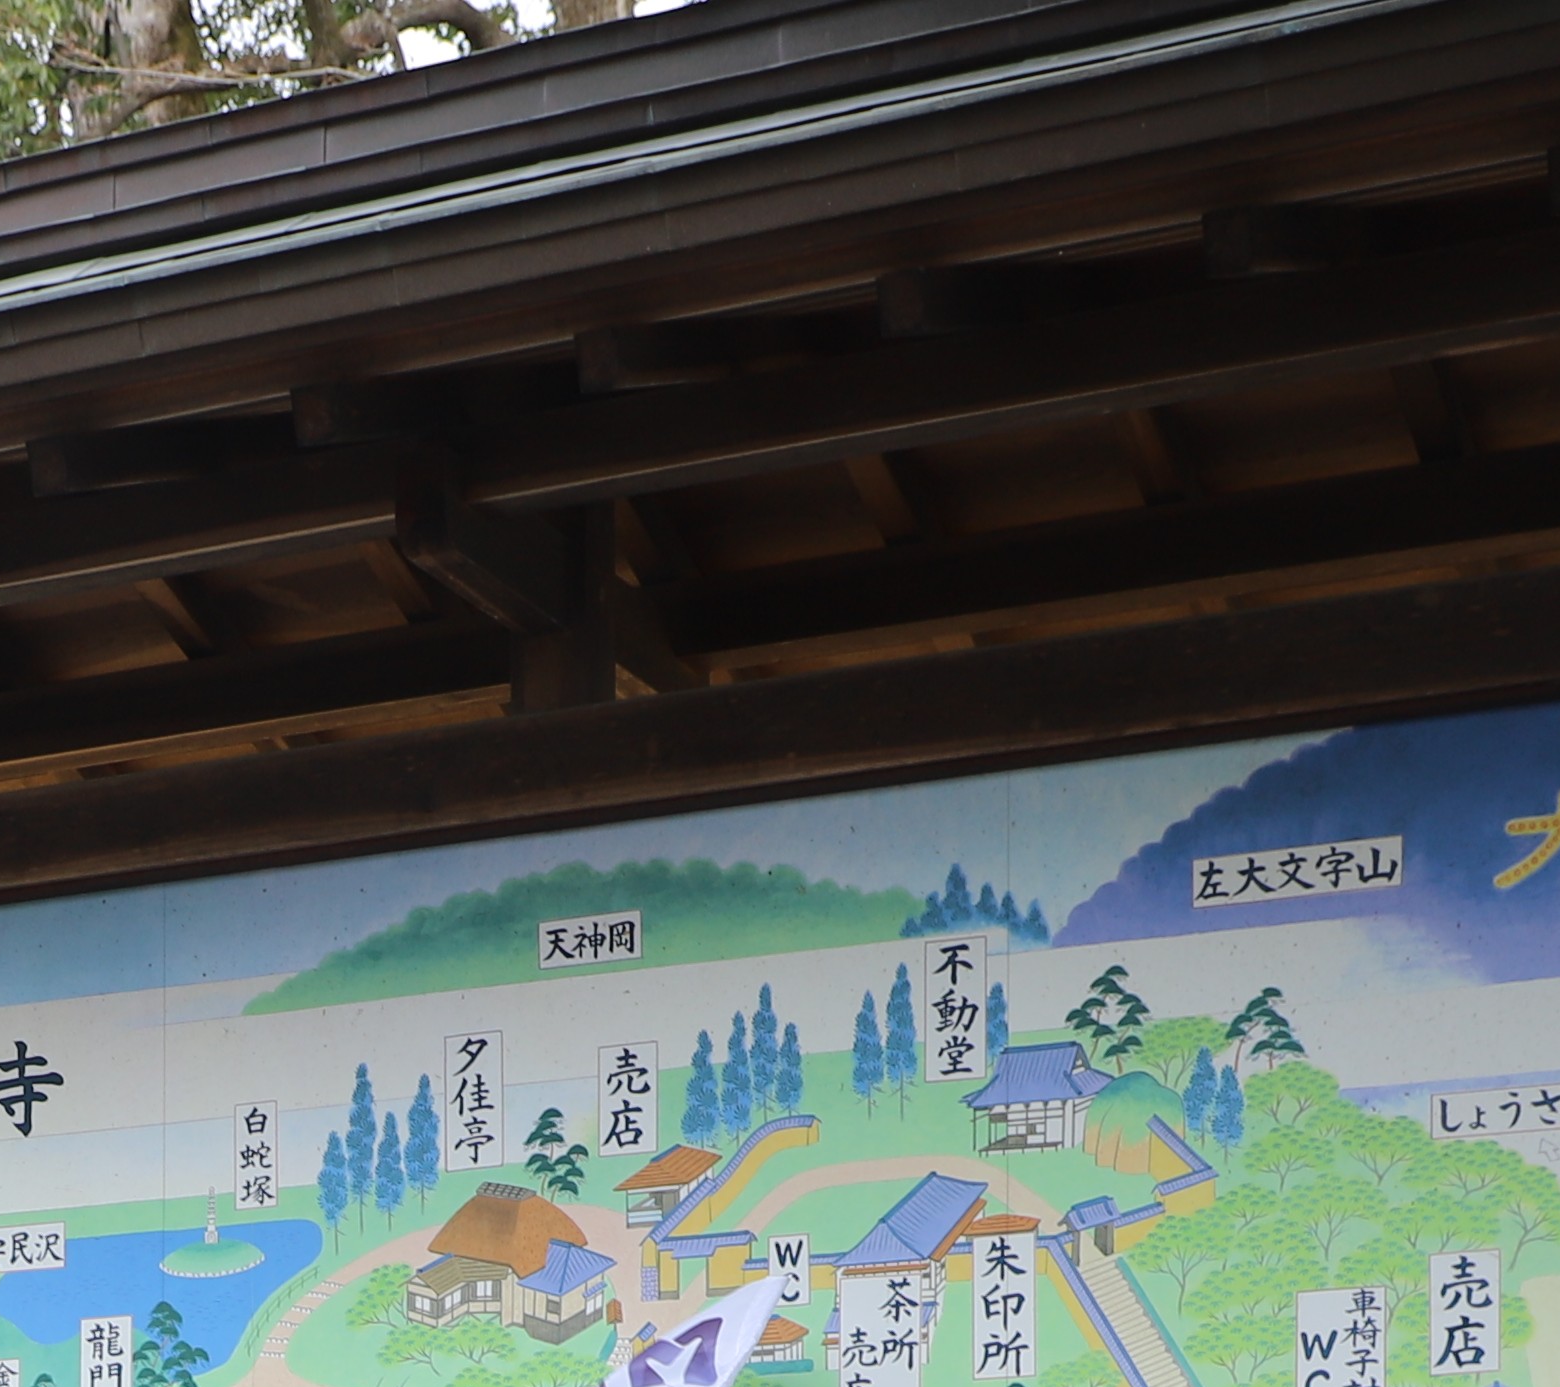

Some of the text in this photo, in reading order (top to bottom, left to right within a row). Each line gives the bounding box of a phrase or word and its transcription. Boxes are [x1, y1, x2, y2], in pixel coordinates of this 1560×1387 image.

[1196, 845, 1399, 900] 左大文字山
[544, 920, 636, 961] 天神岡
[931, 943, 979, 1076] 不動堂
[452, 1037, 495, 1164] 夕佳亭
[602, 1047, 651, 1148] 売店
[240, 1106, 275, 1205] 白蛇塚
[879, 1277, 920, 1371] 茶所
[975, 1234, 1029, 1376] 朱印所
[1435, 1255, 1493, 1368] 売店
